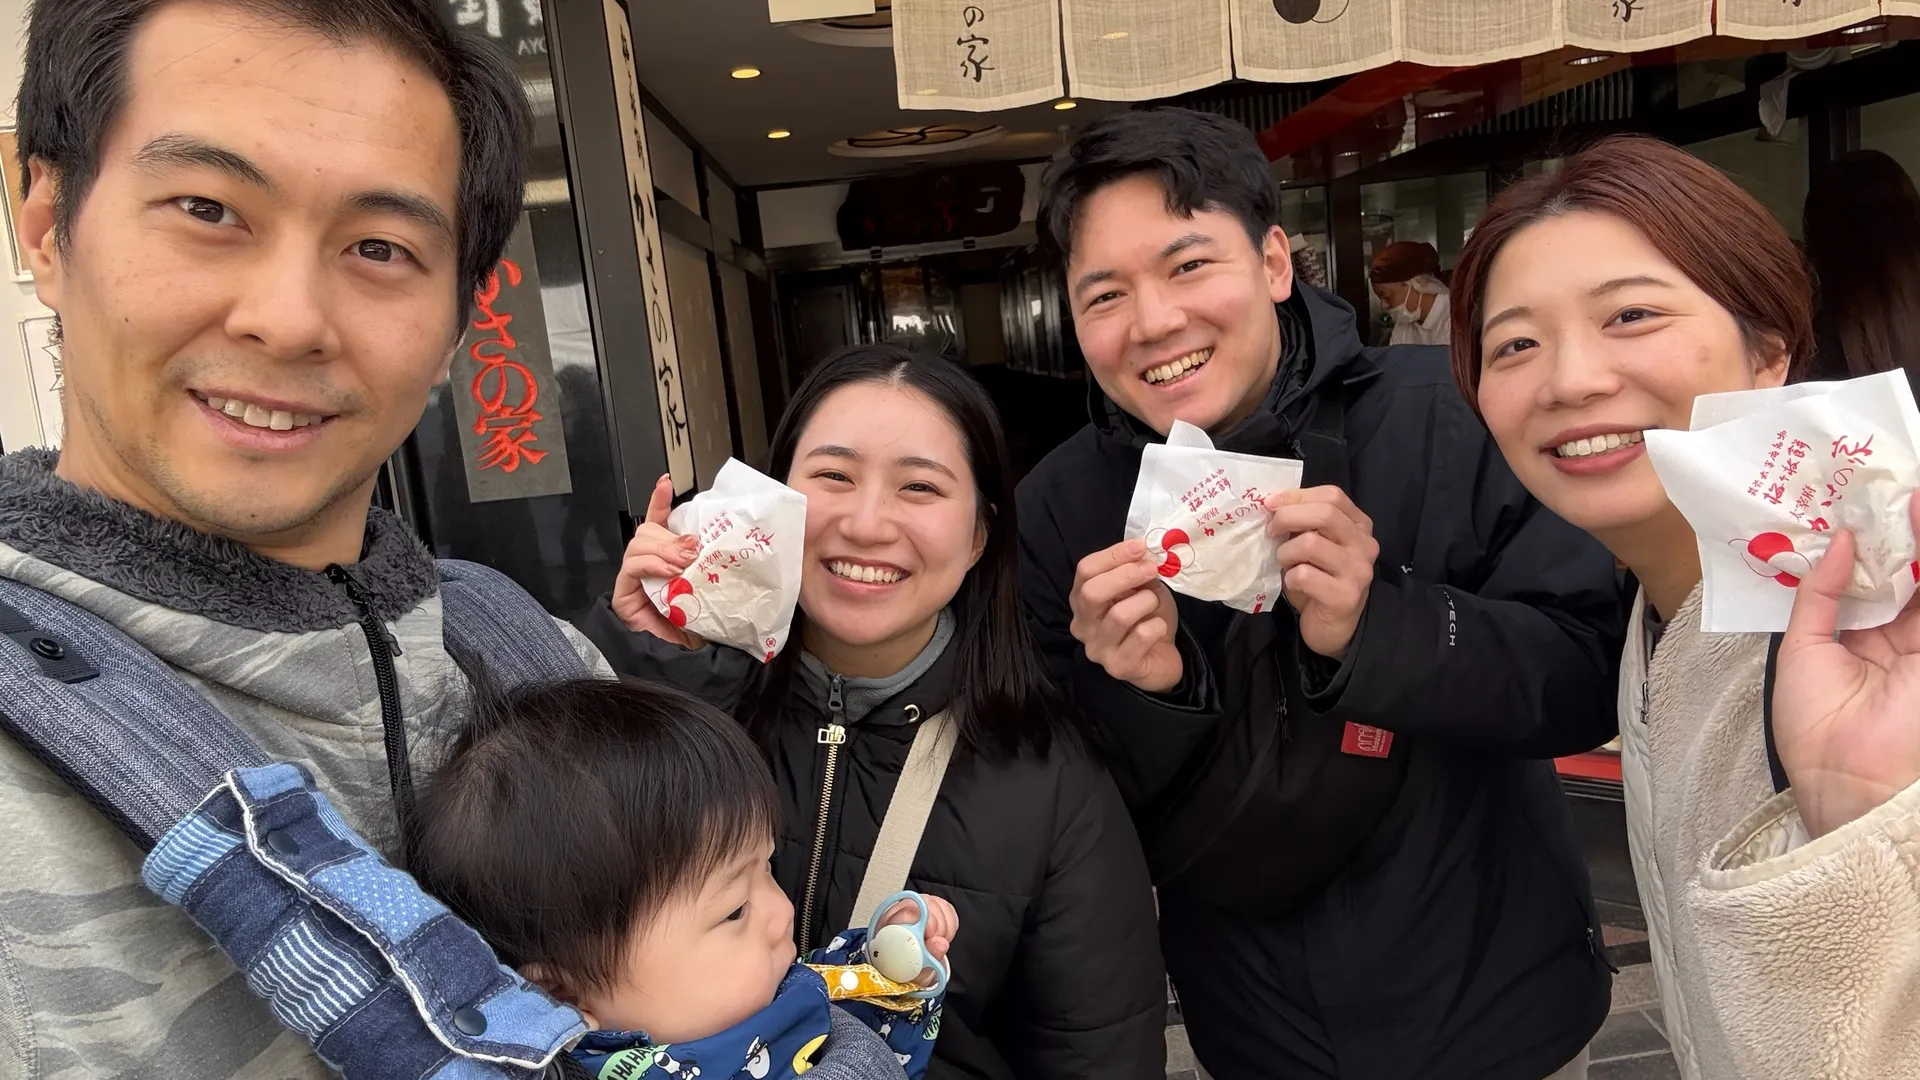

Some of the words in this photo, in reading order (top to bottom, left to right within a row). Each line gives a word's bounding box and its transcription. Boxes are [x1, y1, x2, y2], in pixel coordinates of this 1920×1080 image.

[957, 6, 995, 82] の家
[1789, 484, 1816, 521] 太宰府
[1807, 433, 1873, 531] かさの家
[707, 527, 775, 584] かさの家
